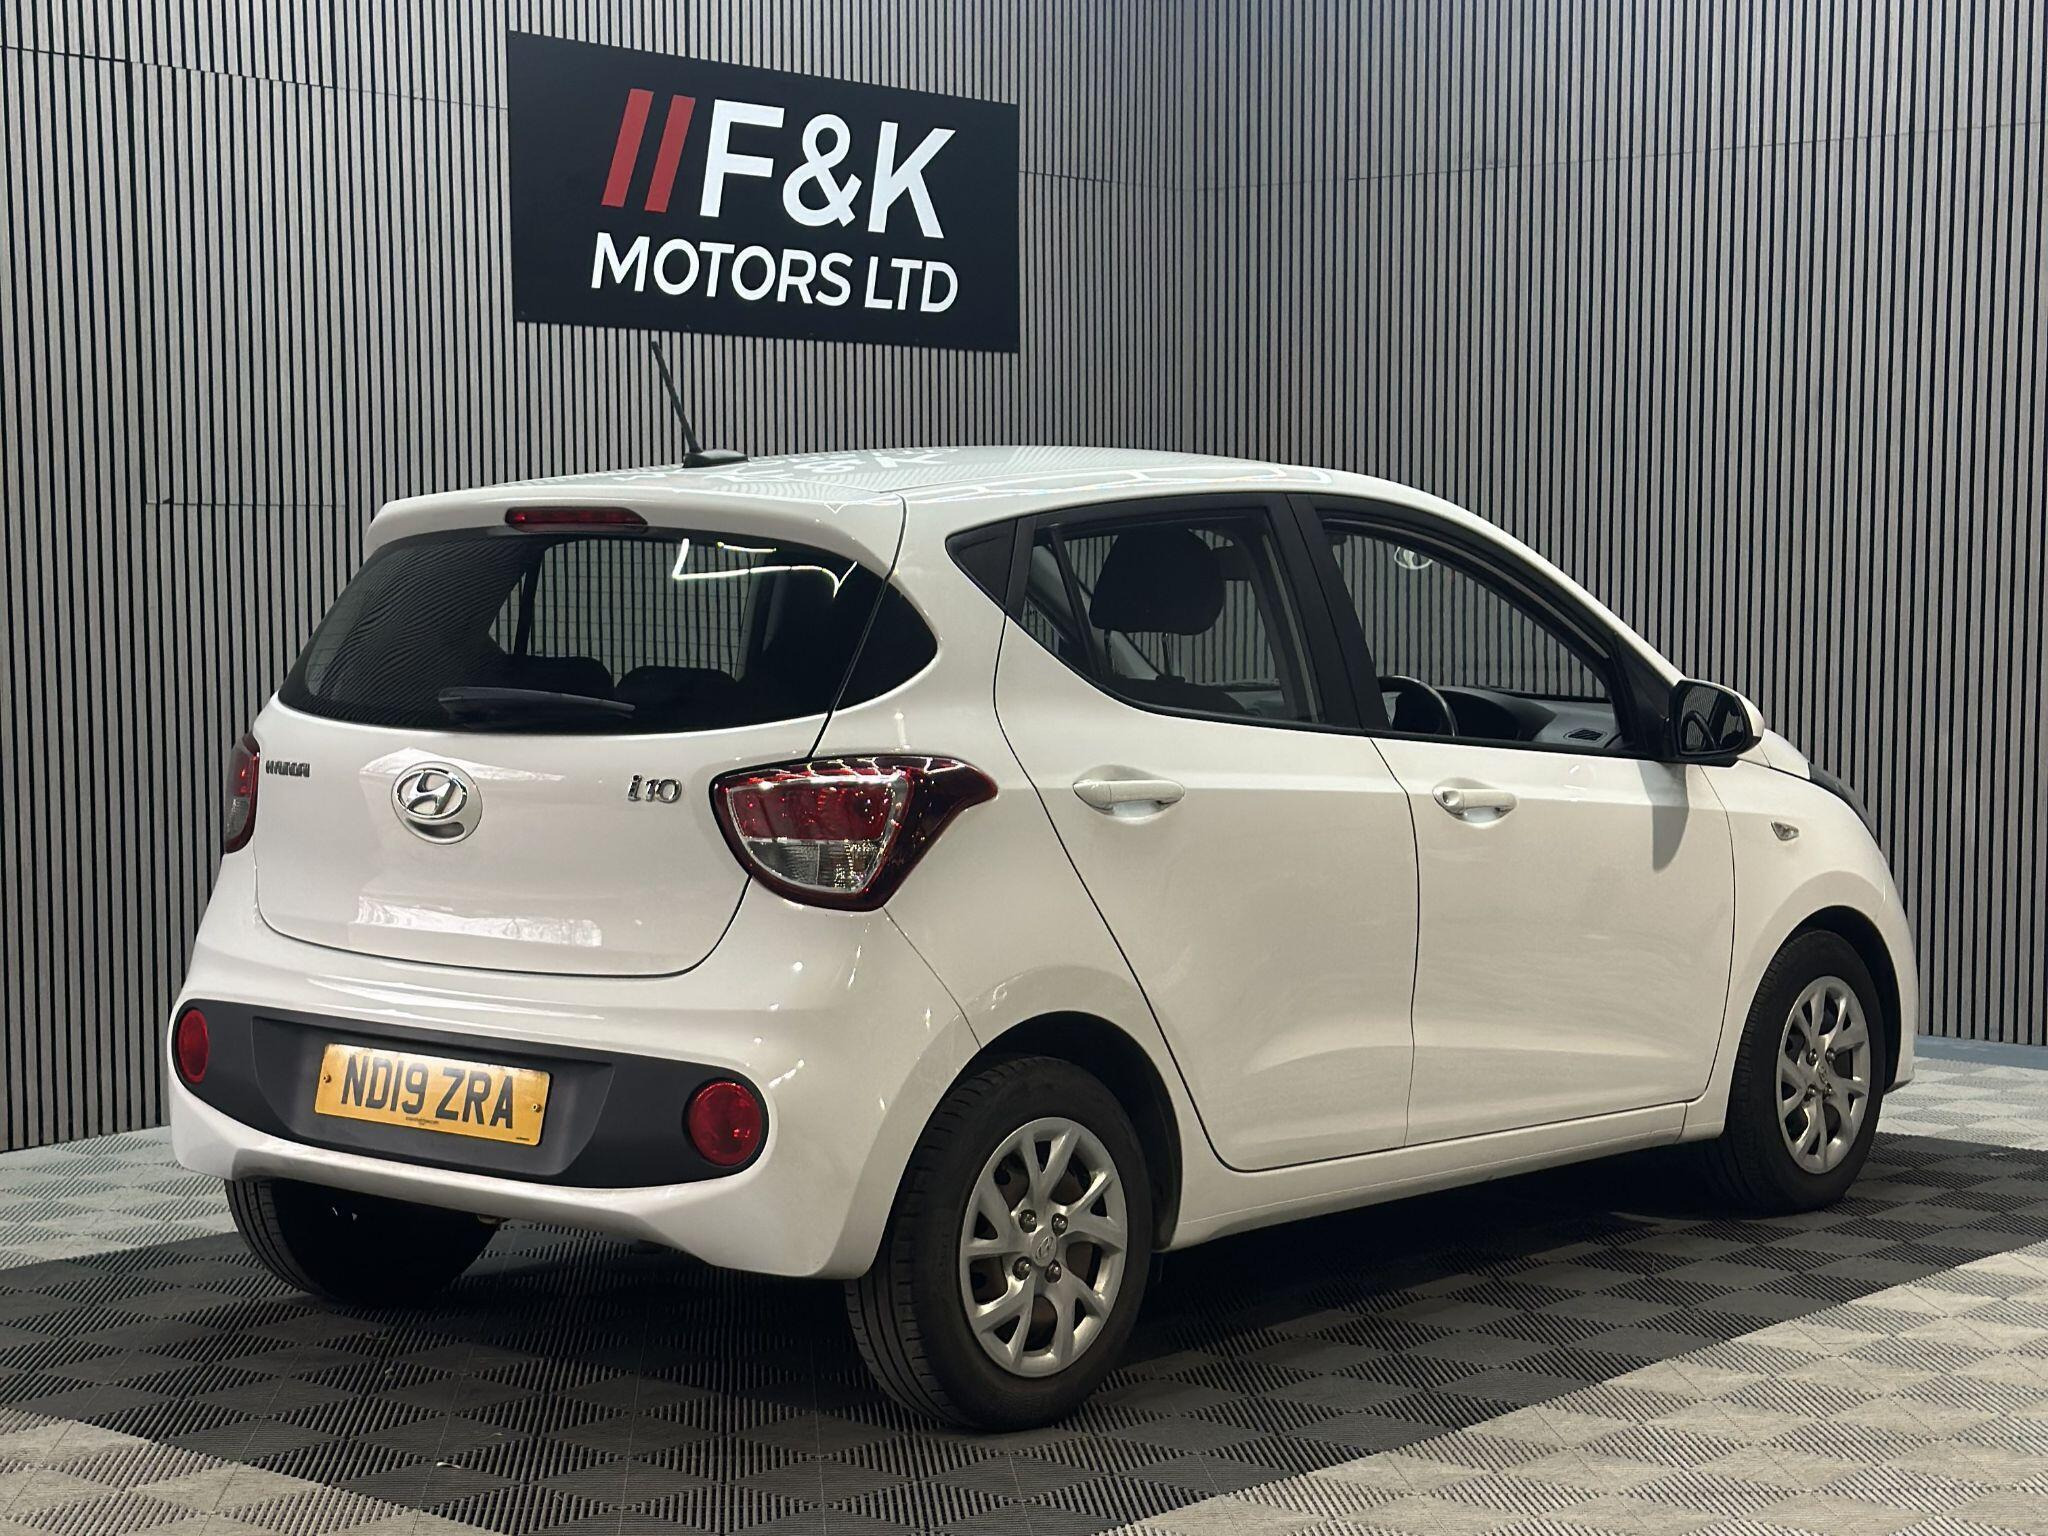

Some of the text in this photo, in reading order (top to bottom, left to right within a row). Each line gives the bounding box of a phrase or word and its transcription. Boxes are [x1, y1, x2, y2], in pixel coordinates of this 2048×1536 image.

[700, 99, 956, 238] F&K
[592, 232, 959, 312] MOTORS LTD
[627, 774, 682, 803] i10
[341, 1055, 514, 1129] ND19 ZRA
